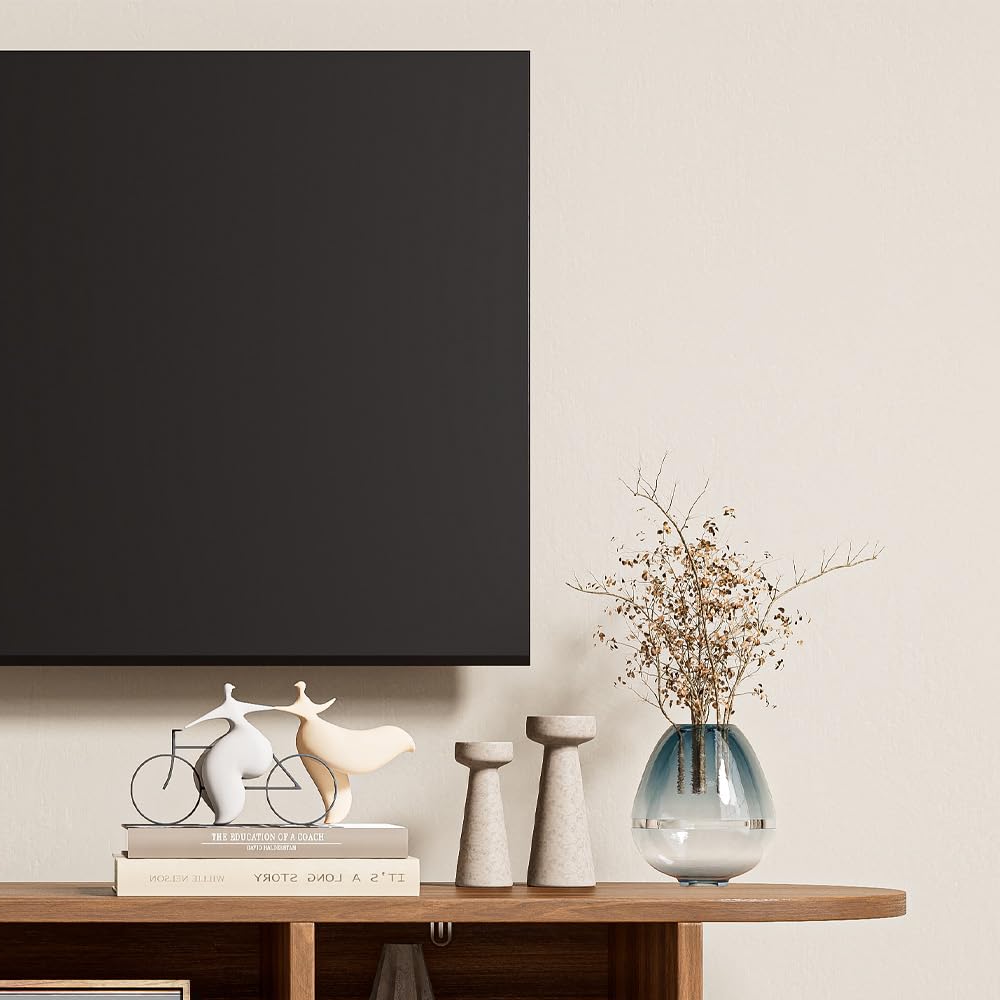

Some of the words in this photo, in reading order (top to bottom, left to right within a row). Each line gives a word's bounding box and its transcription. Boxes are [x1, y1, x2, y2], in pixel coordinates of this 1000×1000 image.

[211, 832, 228, 841] THE
[230, 832, 276, 841] EDUCATION
[278, 832, 289, 841] OF
[290, 832, 297, 841] A
[298, 832, 325, 841] COACH
